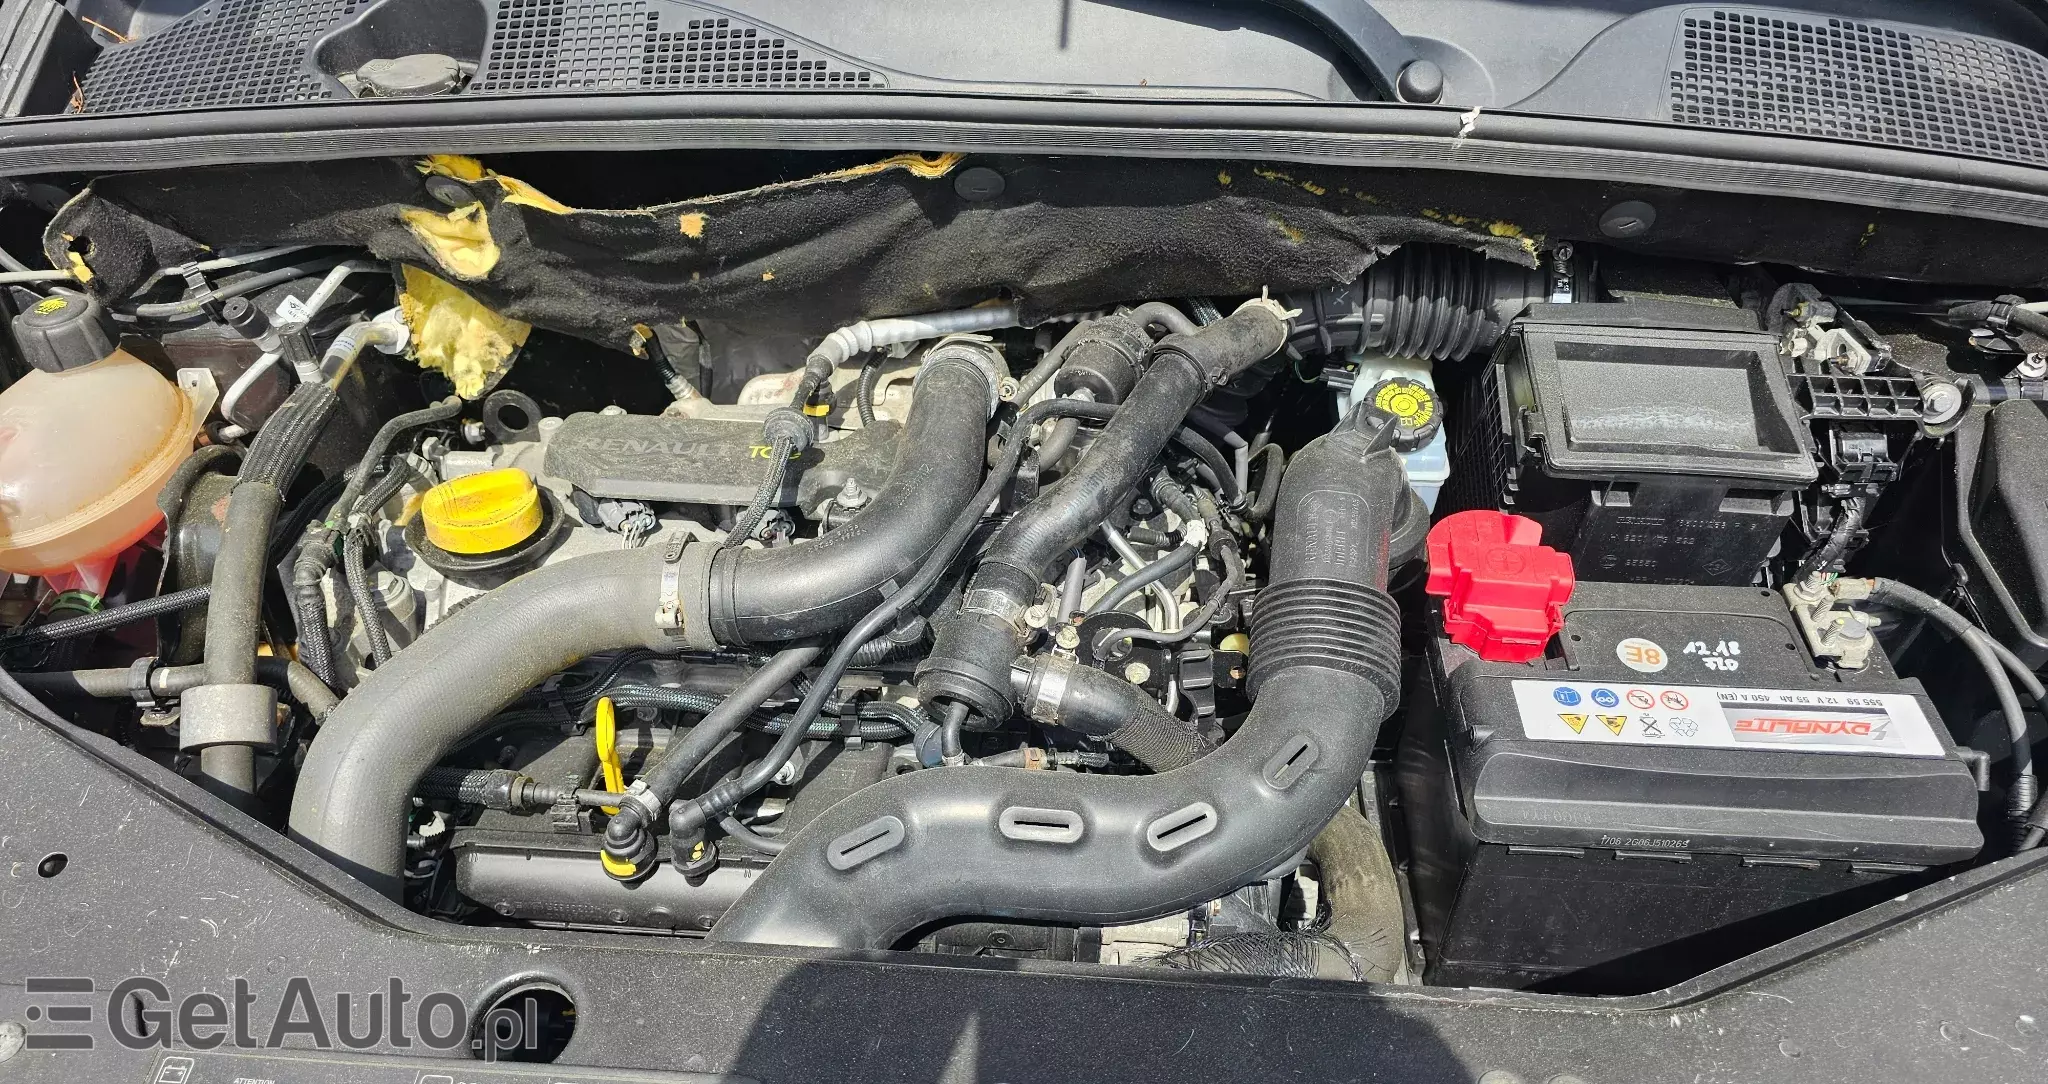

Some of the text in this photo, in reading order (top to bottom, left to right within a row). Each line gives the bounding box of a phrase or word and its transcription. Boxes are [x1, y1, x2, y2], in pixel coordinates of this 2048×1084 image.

[1624, 644, 1661, 666] 8E
[1716, 691, 1738, 701] (EN)
[1779, 694, 1793, 703] Ah
[1817, 696, 1825, 704] V
[1825, 696, 1839, 704] 12
[1861, 698, 1883, 707] 555
[1734, 718, 1871, 736] DYNALITE
